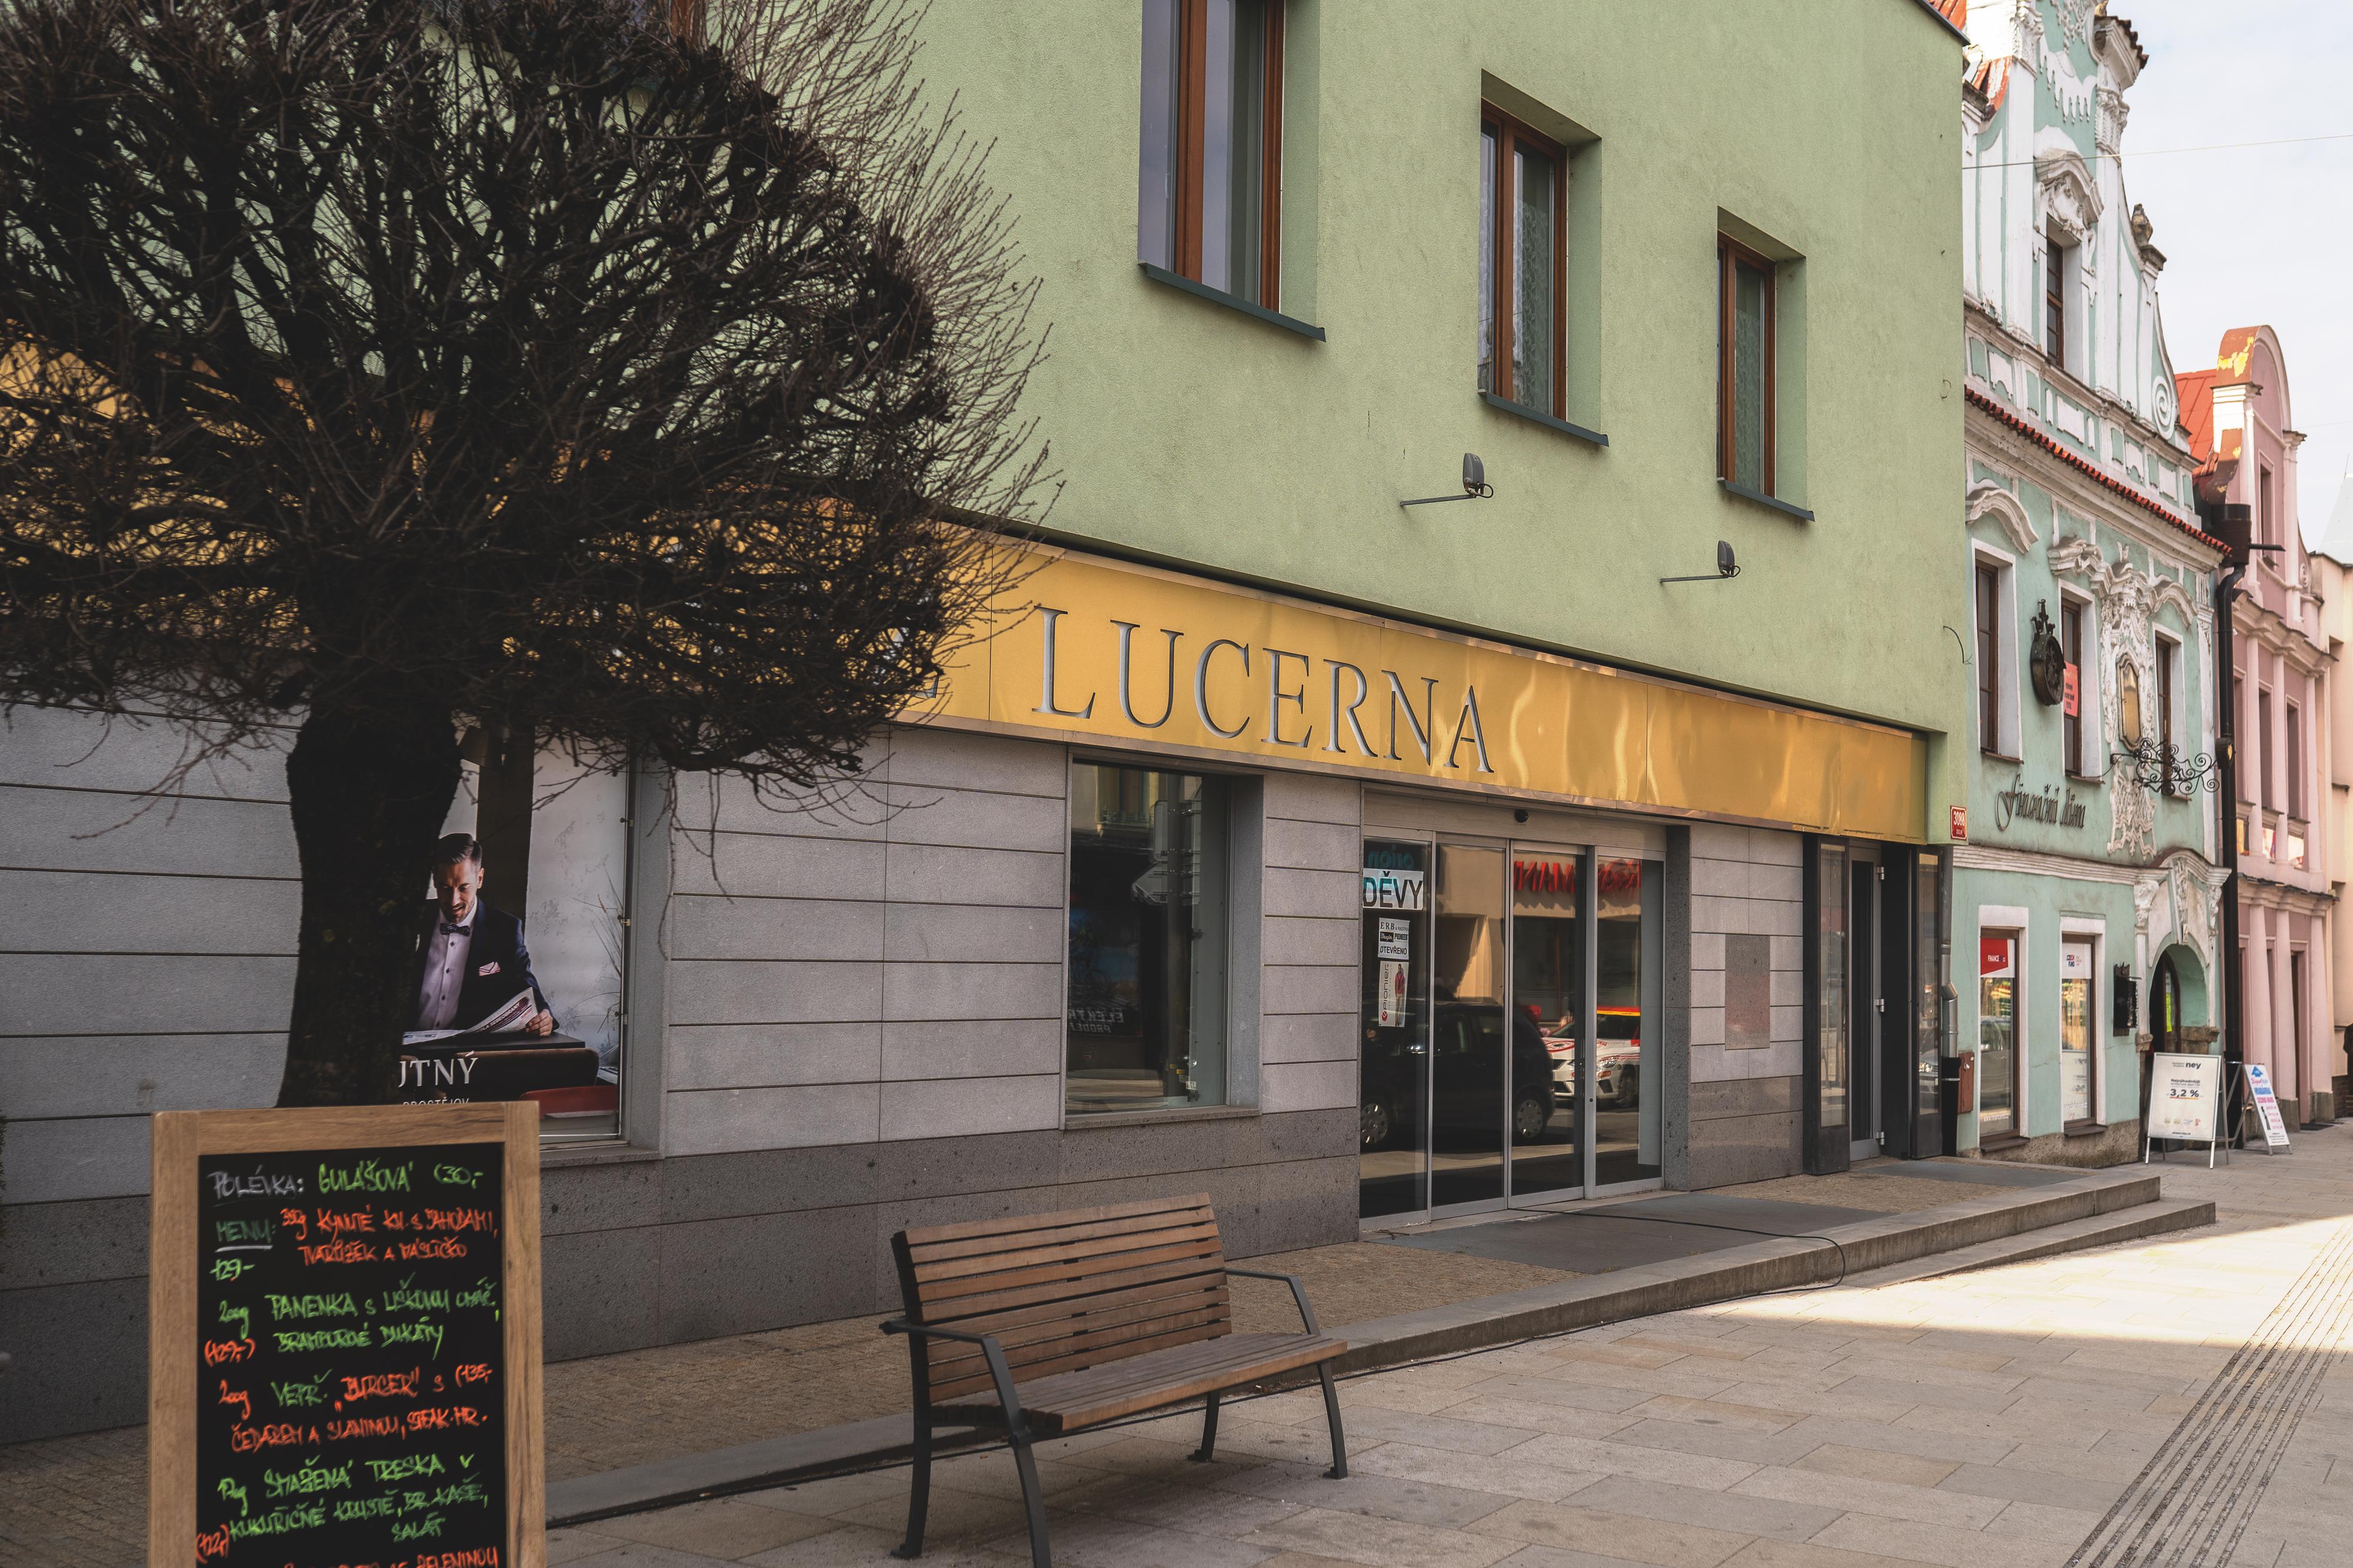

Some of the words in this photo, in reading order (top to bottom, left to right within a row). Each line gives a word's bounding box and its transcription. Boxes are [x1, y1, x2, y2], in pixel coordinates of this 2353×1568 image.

[1032, 605, 1495, 773] LUCERNA
[1954, 811, 1965, 826] 3088
[1380, 945, 1407, 955] OTEVŘENO
[2170, 1088, 2187, 1098] 3,2
[2189, 1089, 2199, 1097] %
[207, 1164, 304, 1200] POLÉVKA:
[384, 1247, 395, 1262] A
[264, 1292, 358, 1321] PANENKA
[308, 1426, 321, 1445] A
[264, 1454, 353, 1499] SMAŽENÁ
[365, 1453, 446, 1482] TRESKA
